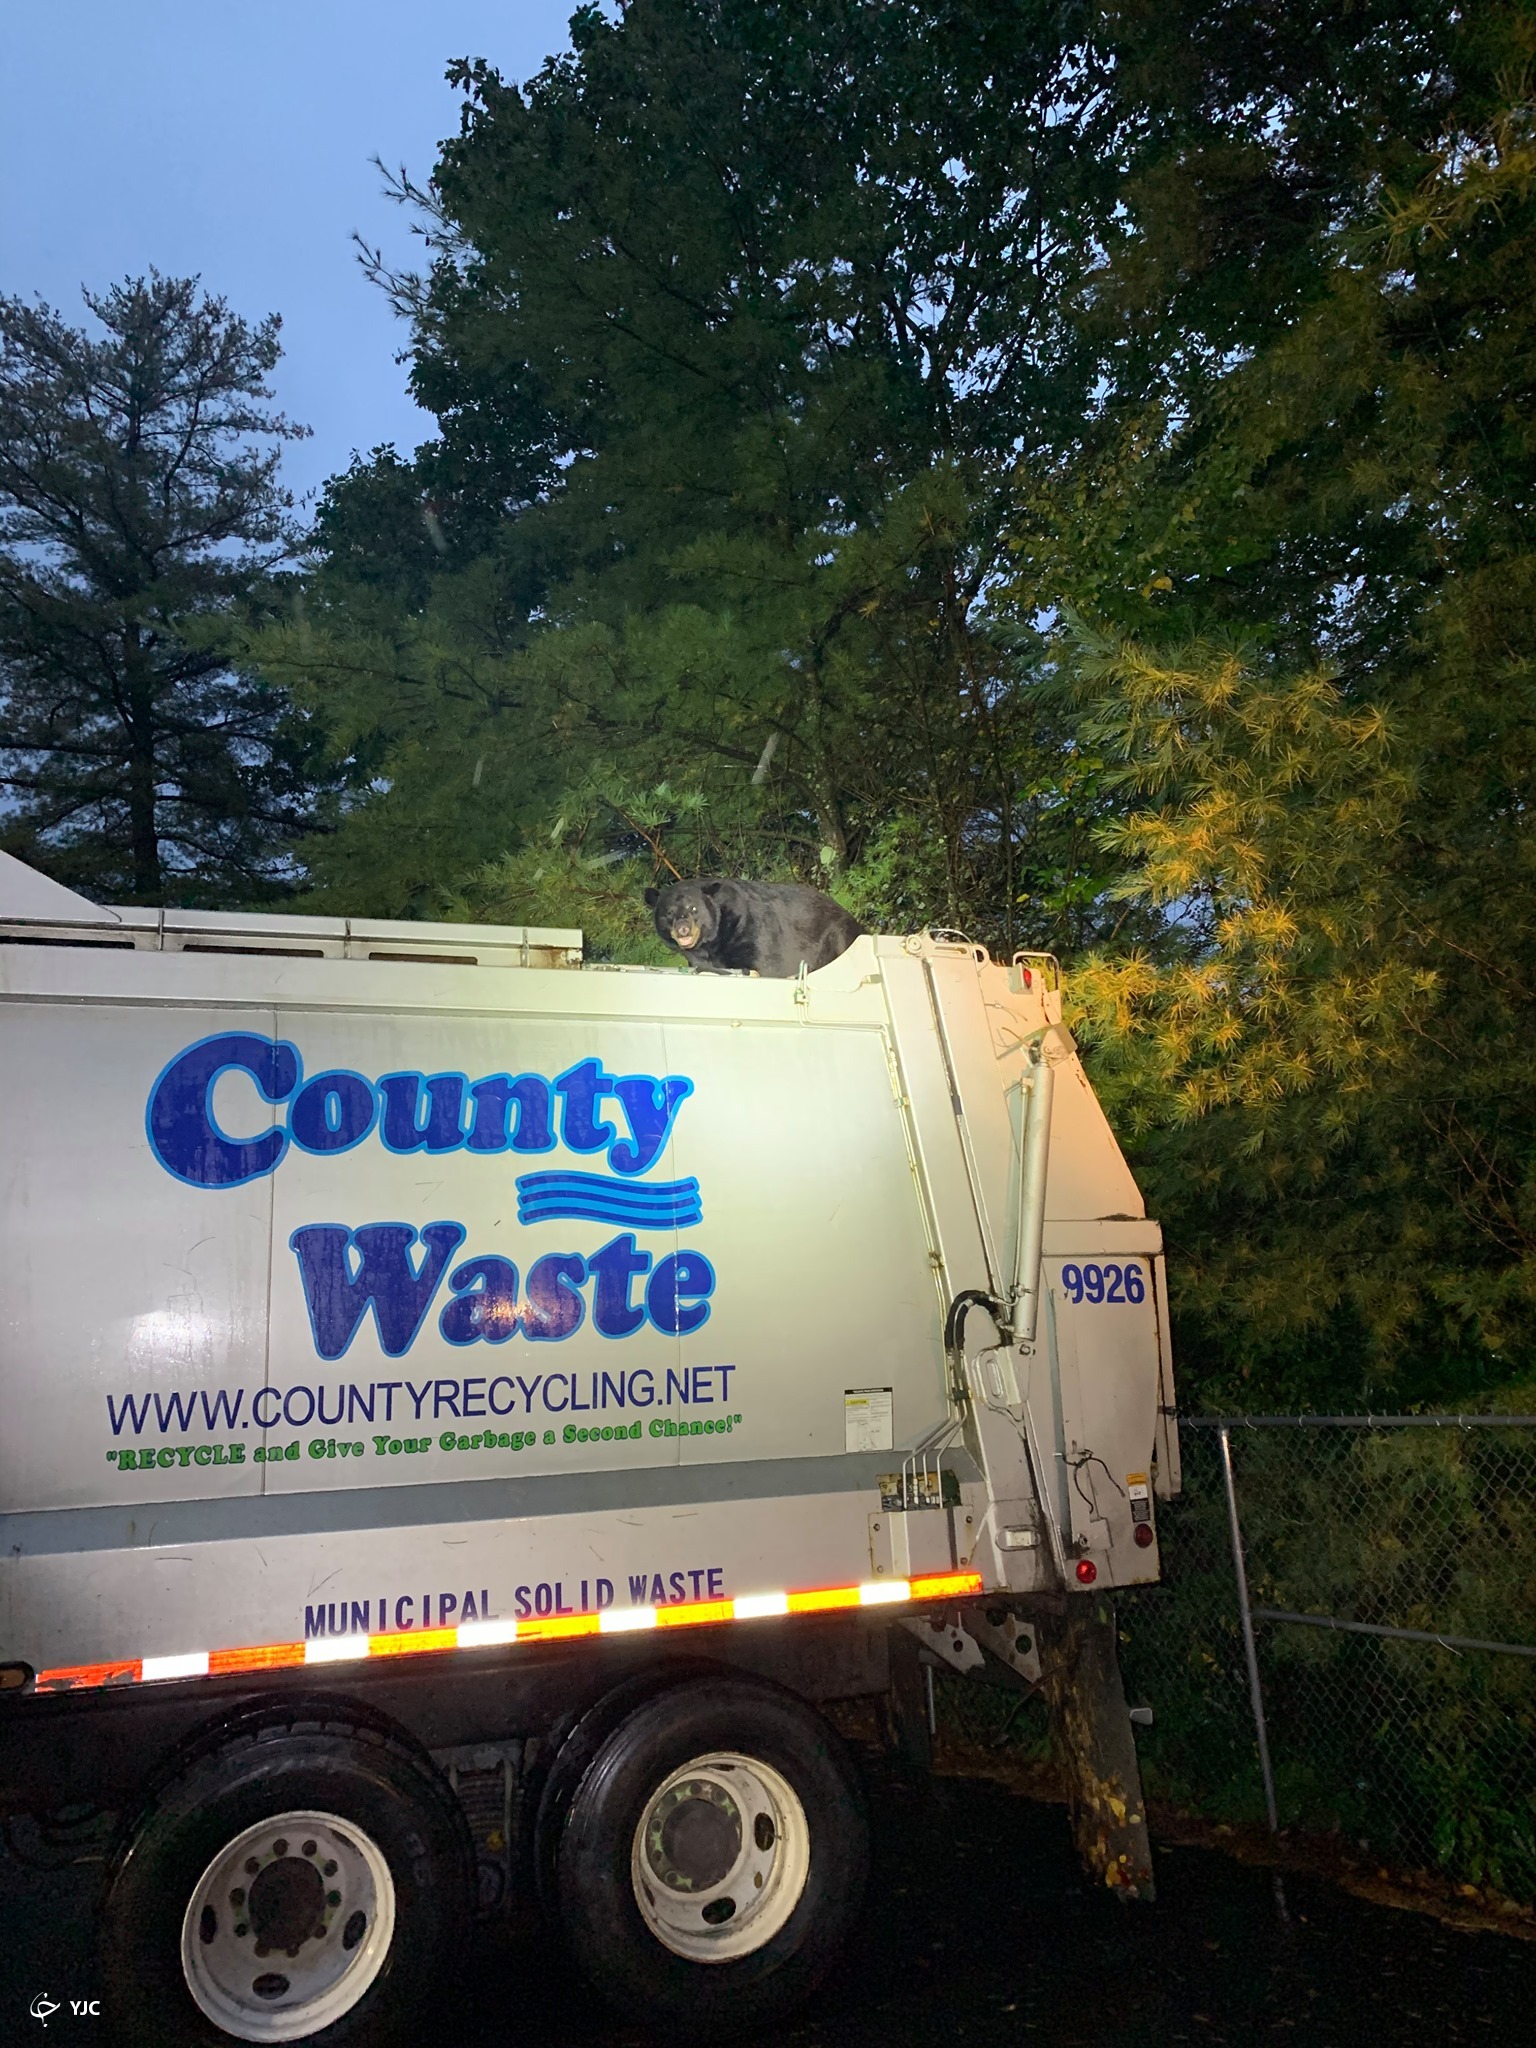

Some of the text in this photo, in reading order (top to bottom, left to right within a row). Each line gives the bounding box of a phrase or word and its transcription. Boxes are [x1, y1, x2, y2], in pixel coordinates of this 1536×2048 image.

[145, 1031, 694, 1189] County
[289, 1222, 716, 1361] Waste
[1062, 1264, 1145, 1304] 9926
[106, 1365, 736, 1436] WWW.COUNTYRECYCLING.NET
[106, 1413, 743, 1470] "RECYCLE and Give Your Garbage a Second Chance!"
[305, 1568, 724, 1639] MUNICIPAL SOLID WASTE
